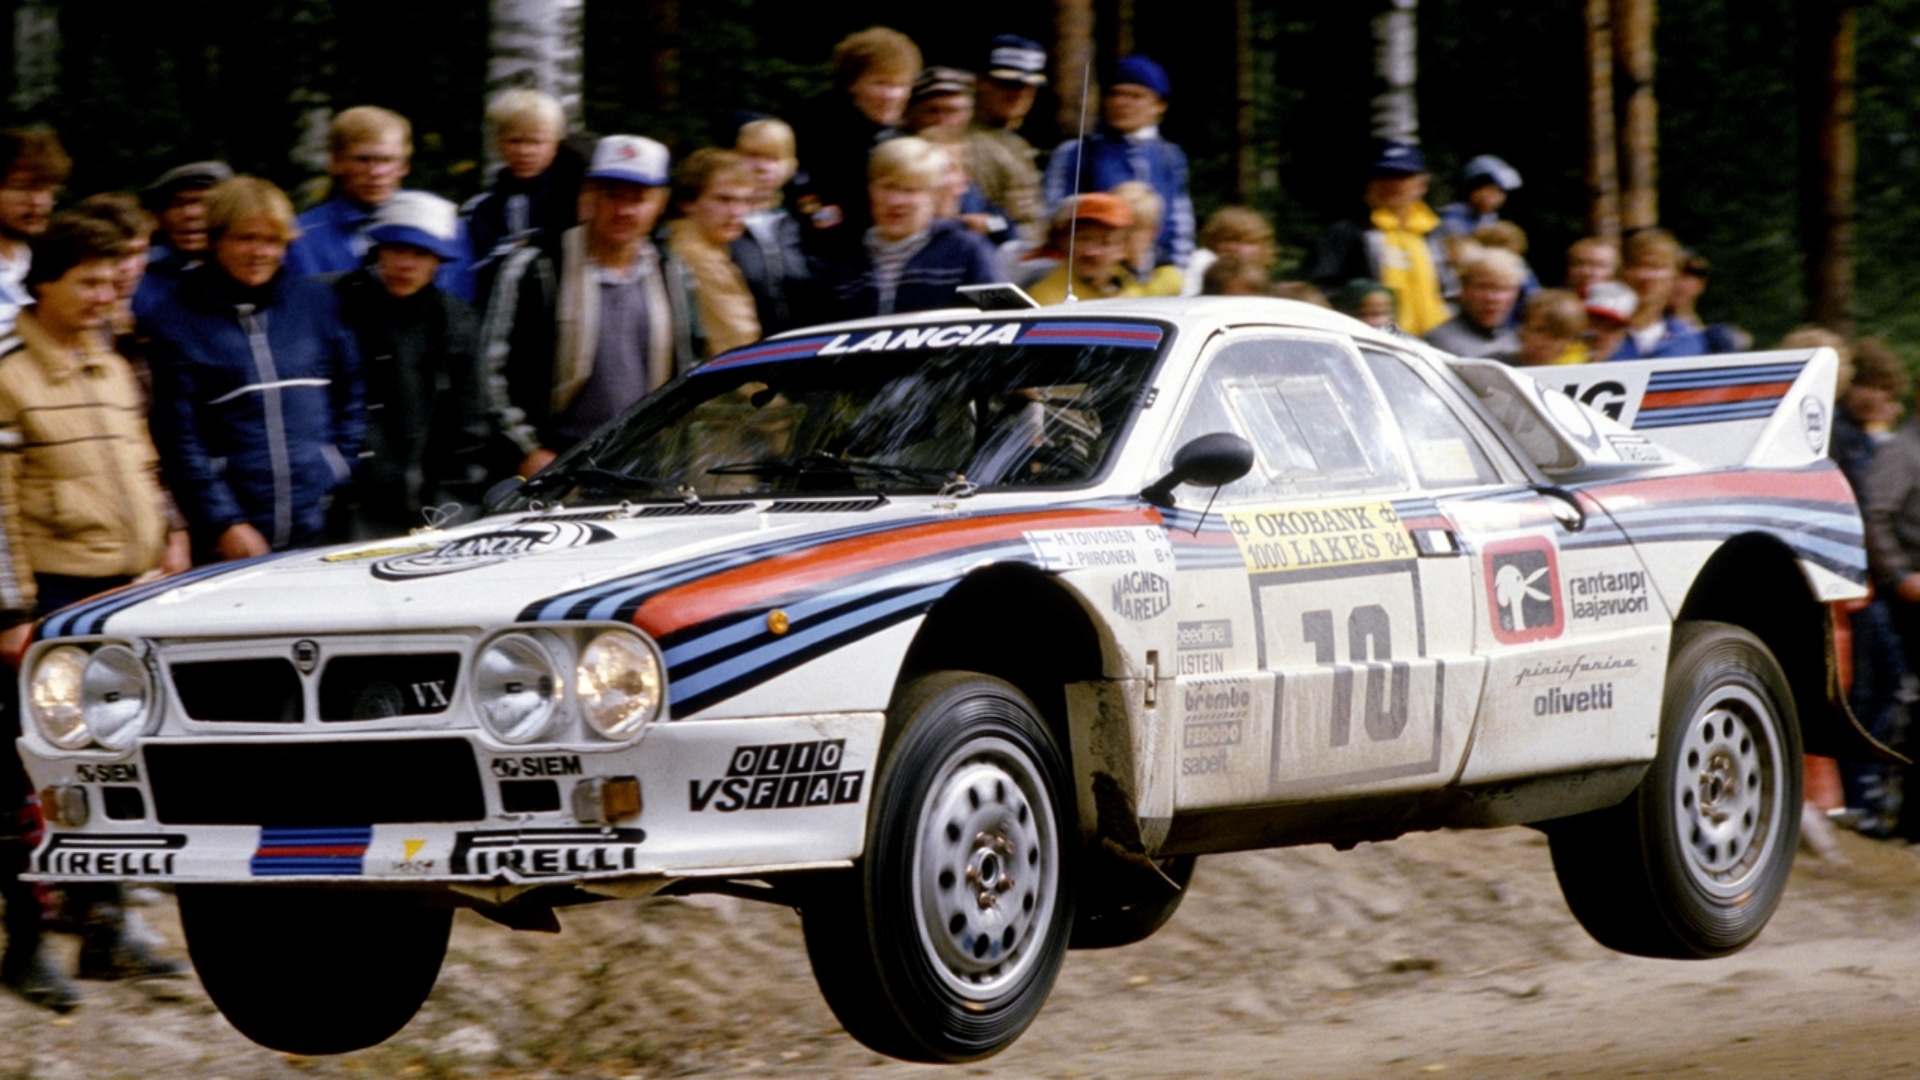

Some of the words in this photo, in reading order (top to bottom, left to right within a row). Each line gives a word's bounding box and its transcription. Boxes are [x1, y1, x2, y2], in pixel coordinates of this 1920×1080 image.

[817, 322, 1022, 356] LANCIA
[1254, 506, 1377, 538] OKOBANK
[436, 536, 530, 557] LANCIA
[1248, 542, 1289, 570] 1000
[1289, 533, 1381, 566] LAKES
[1111, 570, 1171, 600] MAGNETI
[1569, 571, 1646, 597] rantasipi
[1111, 592, 1171, 622] MARELLI
[1571, 590, 1649, 621] laajavuori
[1301, 603, 1410, 748] 10
[1515, 654, 1638, 687] pininfarina
[411, 680, 448, 708] VX
[1184, 687, 1250, 712] brembo
[1534, 682, 1613, 716] olivetti
[522, 755, 583, 776] SIEM
[732, 742, 841, 774] OLIO
[751, 773, 862, 806] FIAT
[38, 833, 188, 875] PIRELLI
[448, 828, 647, 875] PIRELLI
